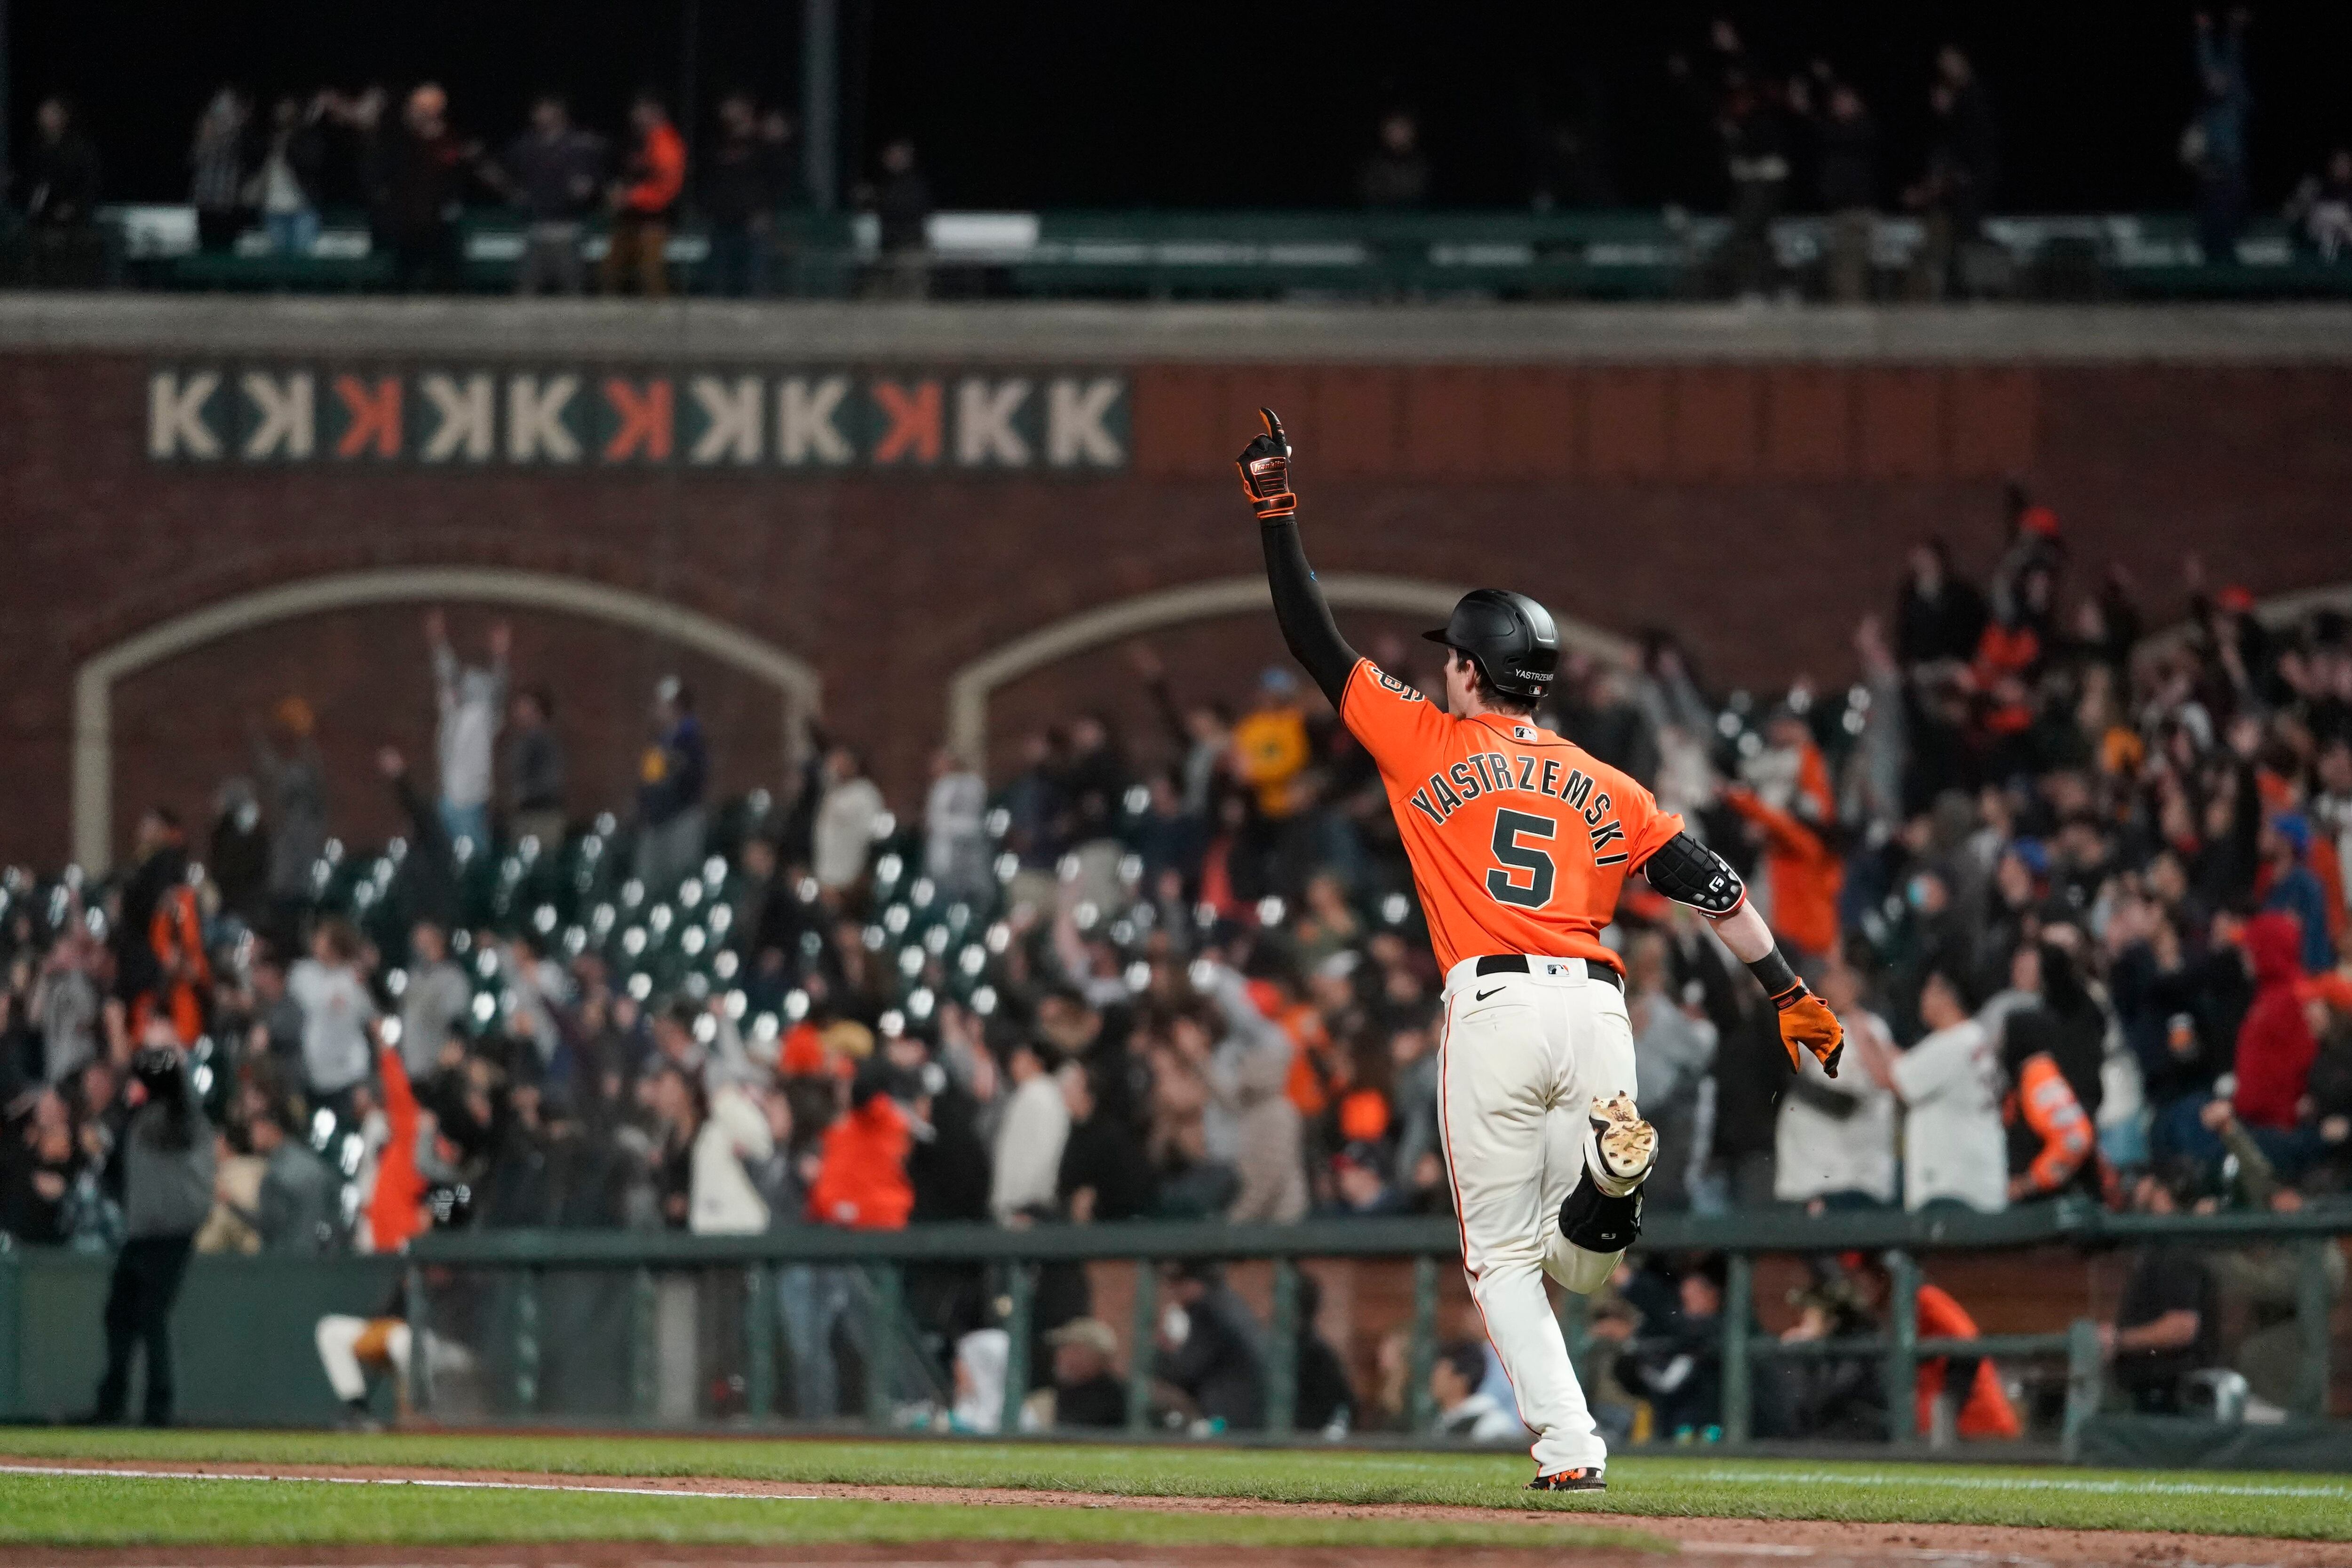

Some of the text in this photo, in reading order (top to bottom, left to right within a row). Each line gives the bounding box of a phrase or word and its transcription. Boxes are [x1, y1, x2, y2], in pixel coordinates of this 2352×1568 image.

[149, 374, 217, 456] K
[507, 374, 579, 462] K
[777, 377, 850, 464] K
[956, 378, 1028, 465] K
[1047, 378, 1121, 466] K
[1515, 668, 1554, 681] YASTRZEMS
[1410, 752, 1629, 868] YASTRZEMSKI
[1485, 806, 1557, 912] 5
